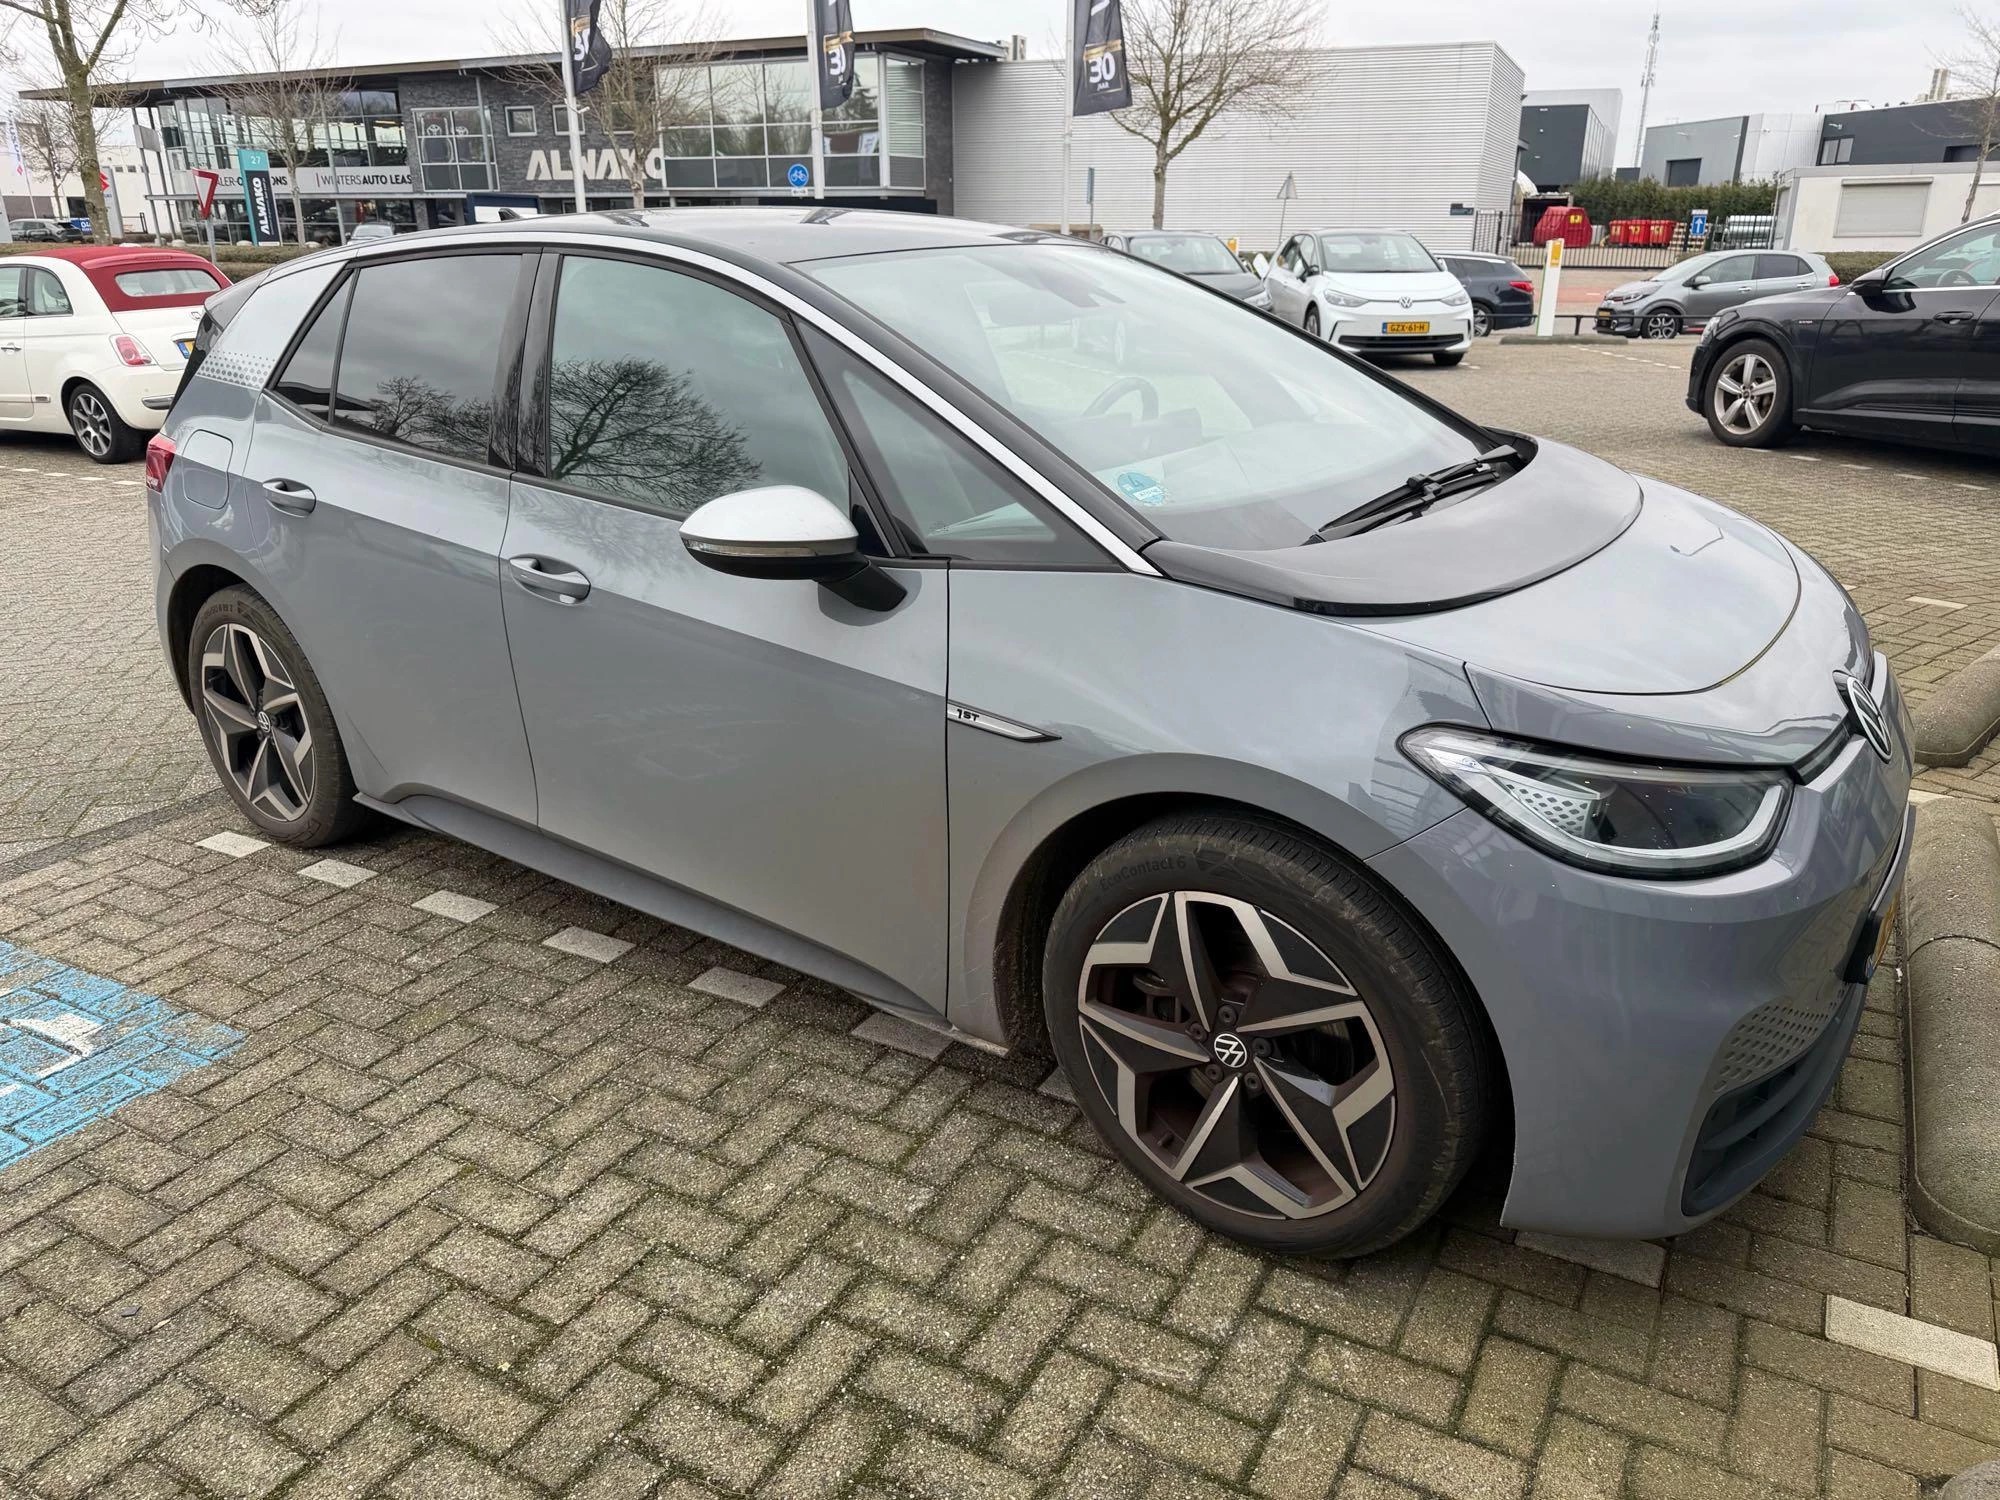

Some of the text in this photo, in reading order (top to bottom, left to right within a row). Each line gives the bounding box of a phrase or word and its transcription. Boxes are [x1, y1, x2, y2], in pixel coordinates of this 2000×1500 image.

[1088, 52, 1116, 84] 30
[250, 155, 261, 165] 27
[362, 174, 389, 185] AUTO
[252, 177, 271, 236] ALWAKO
[1390, 323, 1425, 332] GZX-61-H
[956, 708, 980, 722] 1ST
[1099, 855, 1187, 891] EcoContact 6
